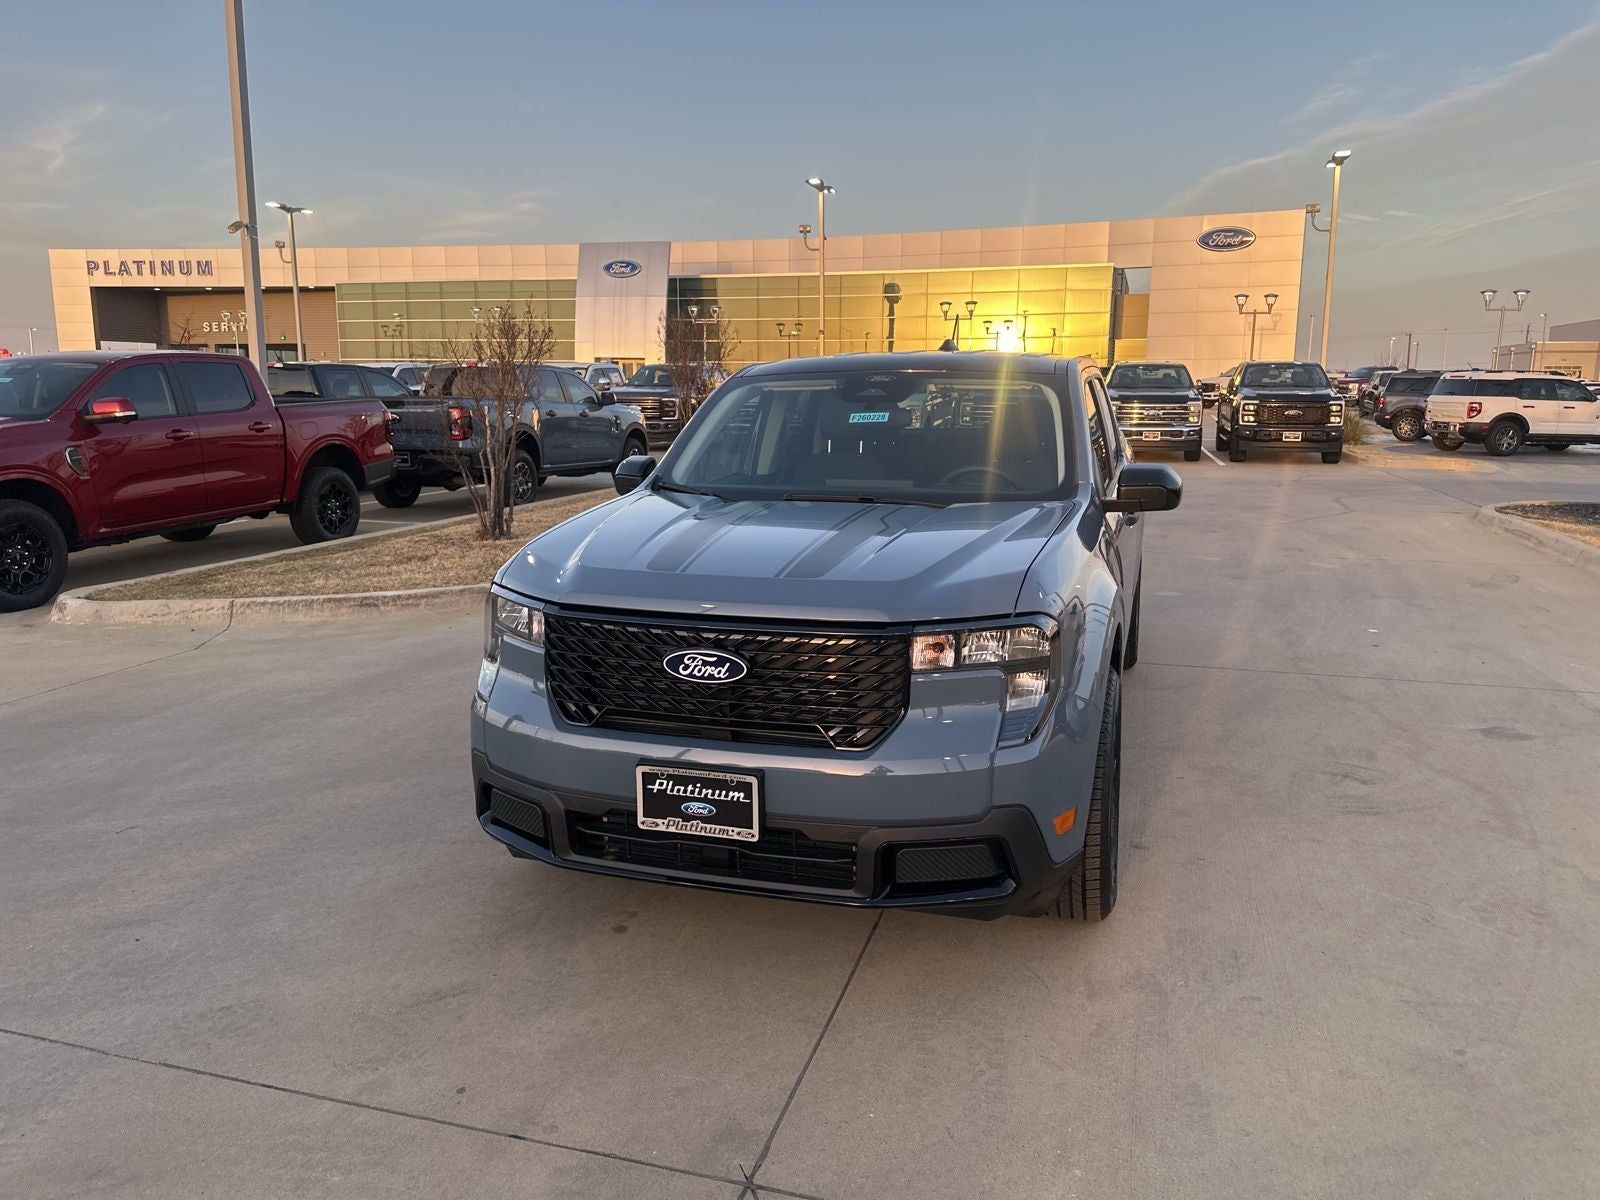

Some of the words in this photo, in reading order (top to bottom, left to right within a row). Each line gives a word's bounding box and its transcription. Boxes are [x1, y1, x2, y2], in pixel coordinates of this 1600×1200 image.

[1209, 231, 1243, 246] Ford
[86, 259, 214, 277] PLATINUM
[609, 262, 632, 273] Ford
[202, 321, 249, 332] SERVI
[851, 413, 887, 422] F260228
[679, 653, 731, 679] Ford
[647, 778, 751, 803] Platinum
[687, 803, 710, 815] Ford
[665, 818, 735, 837] Platinum
